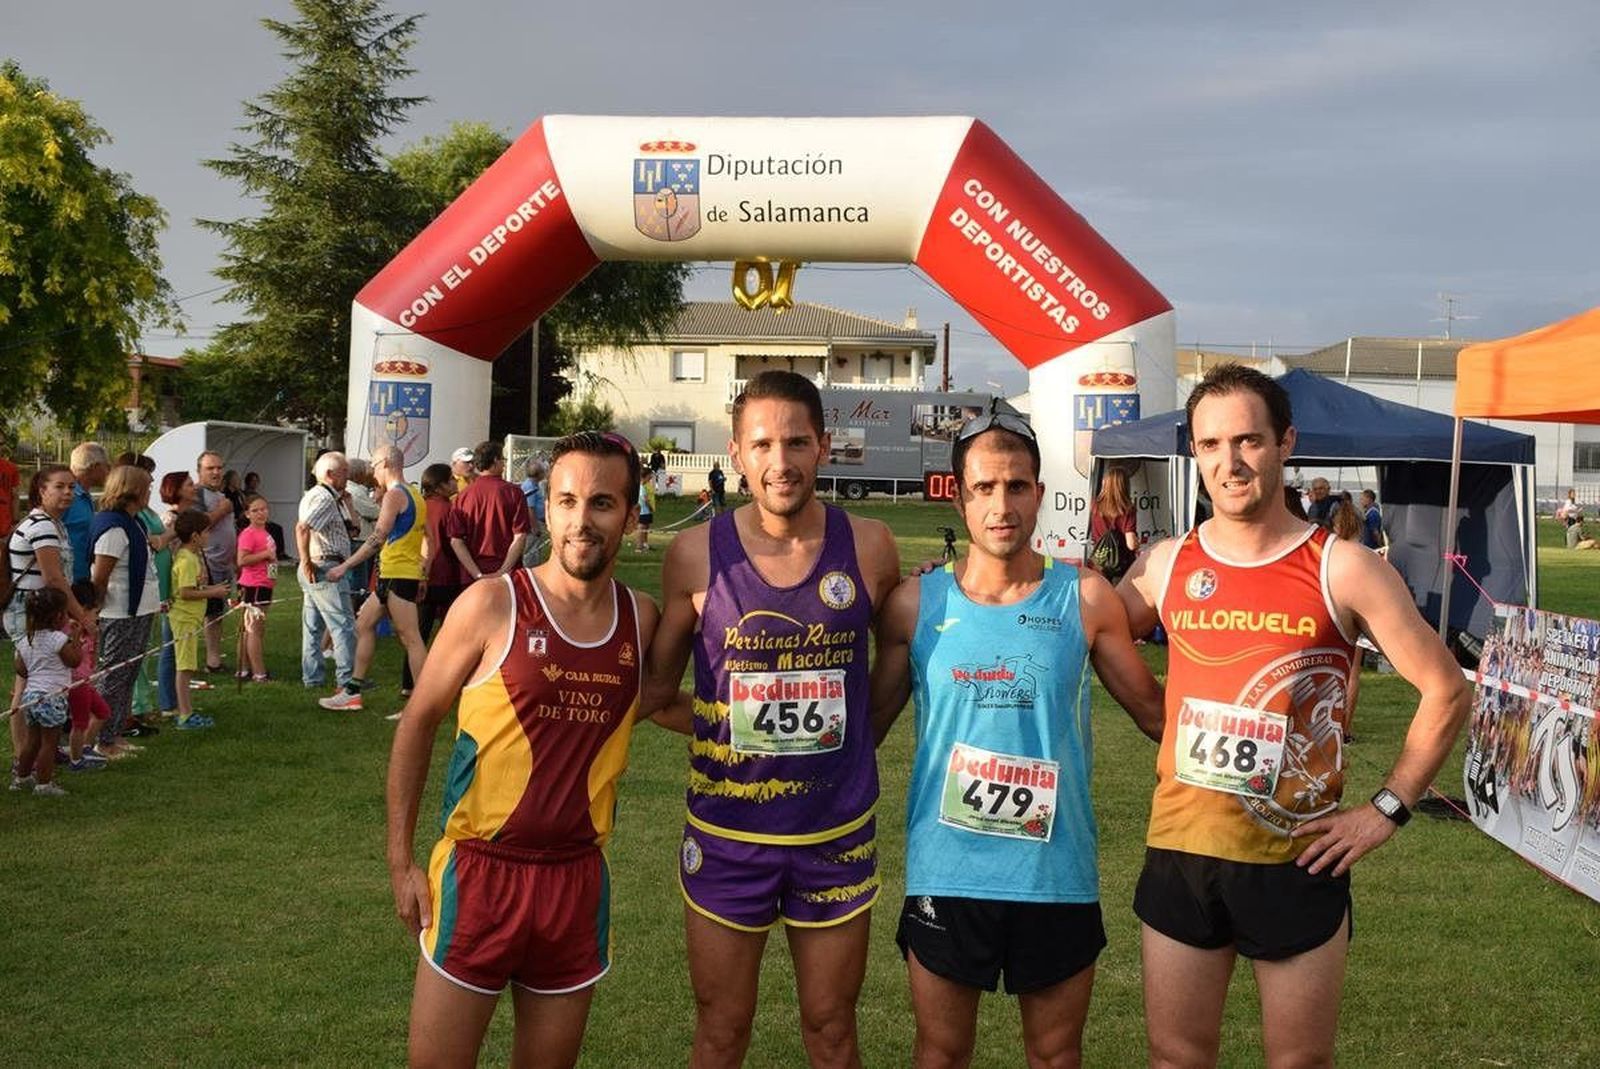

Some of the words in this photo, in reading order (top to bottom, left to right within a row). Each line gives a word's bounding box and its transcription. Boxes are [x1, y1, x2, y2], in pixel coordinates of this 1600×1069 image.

[706, 153, 843, 182] Diputación
[706, 205, 729, 223] de
[738, 200, 869, 224] Salamanca
[399, 285, 444, 328] CON
[441, 264, 473, 290] EL
[468, 180, 562, 266] DEPORTE
[963, 179, 1009, 223] CON
[1006, 220, 1111, 320] NUESTROS
[949, 207, 1080, 334] DEPORTISTAS
[1055, 491, 1160, 515] Dipión
[724, 627, 800, 650] Persianas
[803, 623, 856, 647] Ruano
[1170, 609, 1317, 638] VILLORUELA
[777, 647, 854, 671] Macotera
[564, 670, 591, 682] CAJA
[592, 672, 622, 685] RURAL
[732, 675, 843, 702] bedunia
[538, 704, 562, 720] DE
[558, 690, 603, 707] VINO
[753, 701, 824, 735] 456
[1189, 732, 1258, 773] 468
[950, 748, 1056, 790] bedunia
[962, 779, 1034, 818] 479
